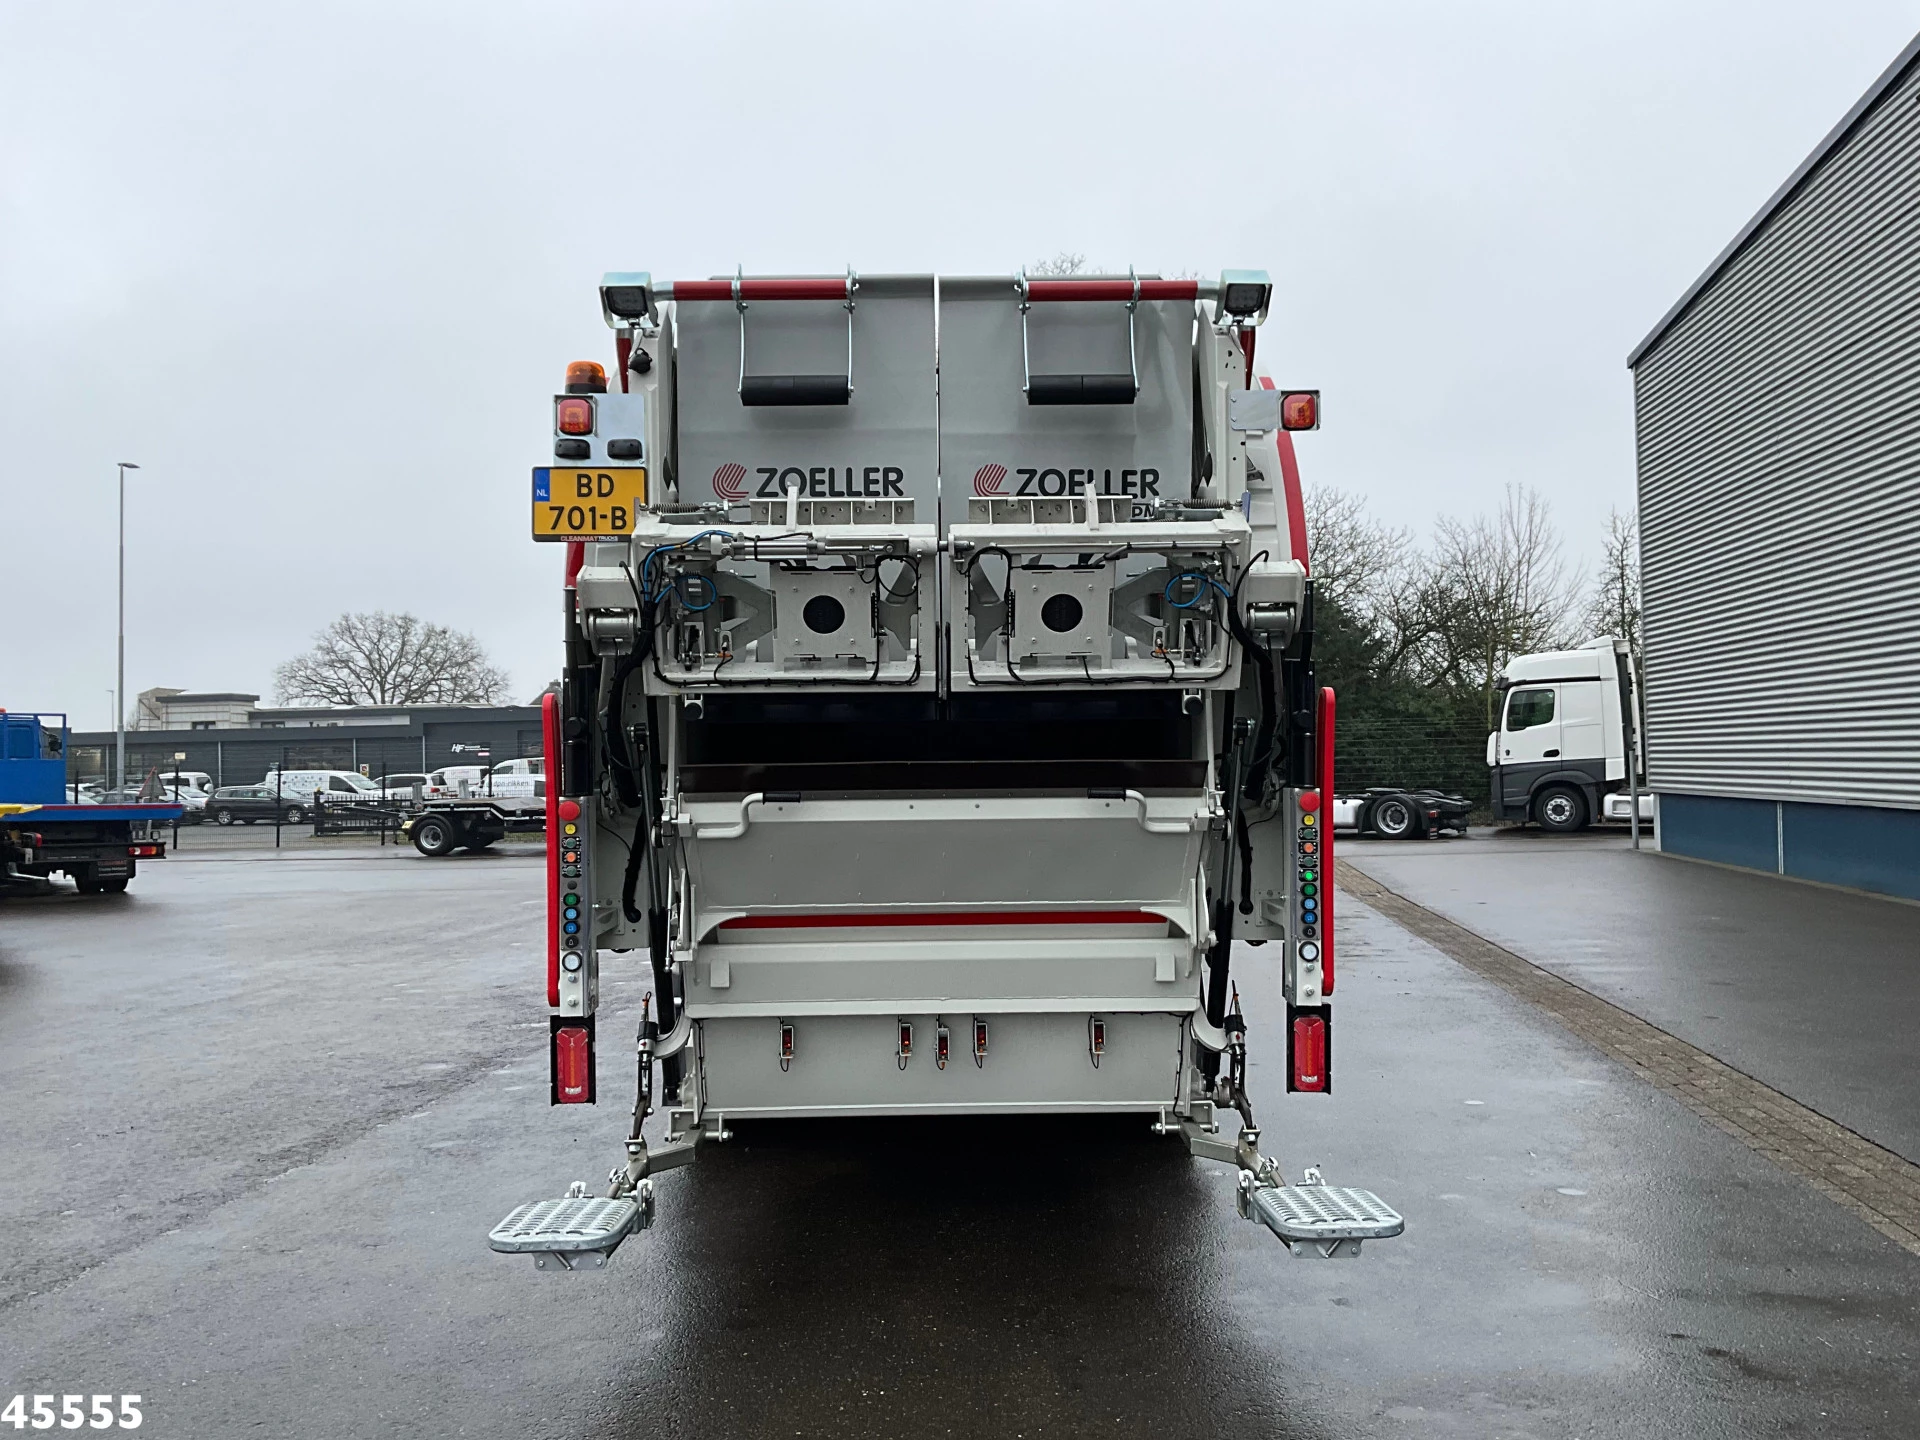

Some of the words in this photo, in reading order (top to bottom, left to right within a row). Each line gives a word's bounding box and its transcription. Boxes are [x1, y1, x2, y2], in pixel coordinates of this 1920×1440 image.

[536, 489, 548, 497] NL
[576, 473, 615, 498] BD
[756, 467, 904, 498] ZOELLER
[549, 505, 627, 530] 701-B
